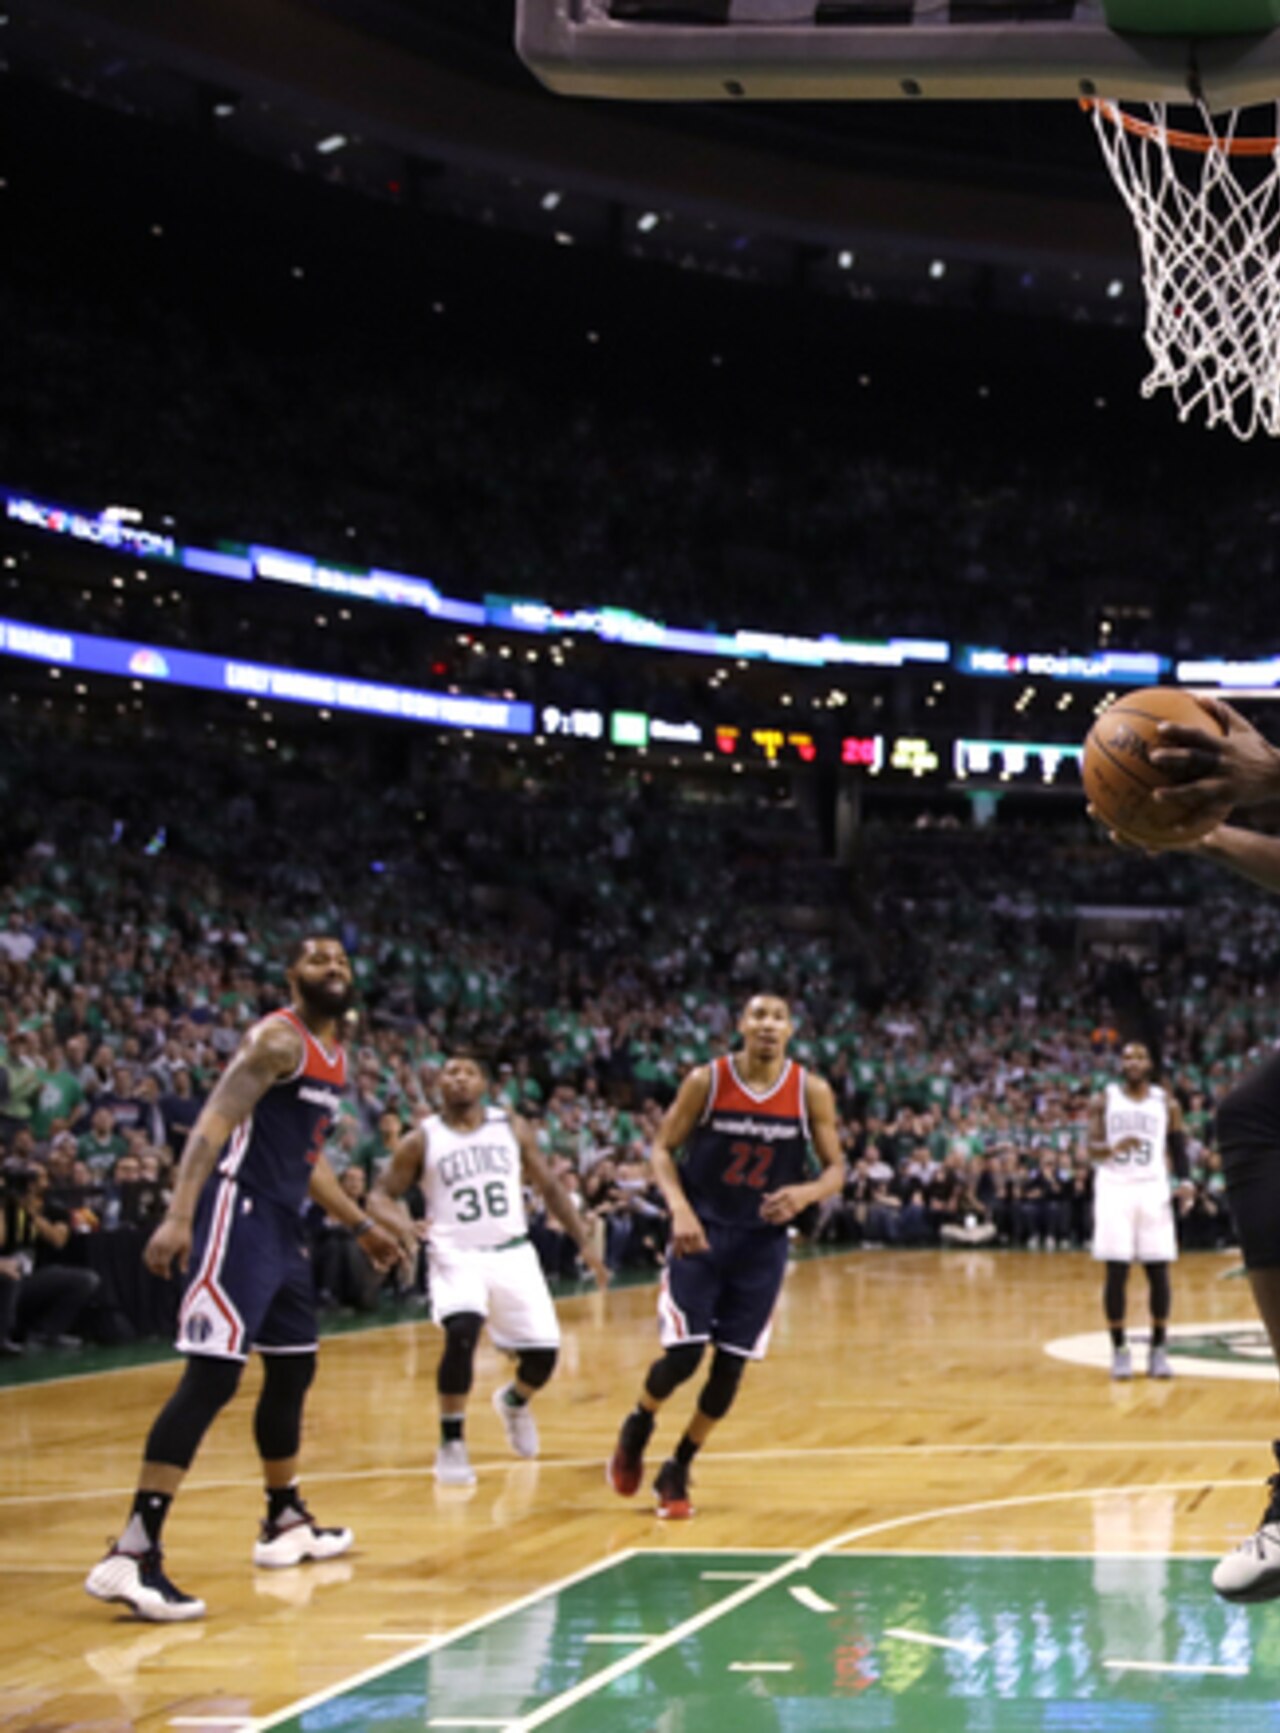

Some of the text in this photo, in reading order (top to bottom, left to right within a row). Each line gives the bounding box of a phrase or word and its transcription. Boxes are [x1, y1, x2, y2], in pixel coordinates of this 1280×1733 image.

[436, 1142, 512, 1187] CELTICS
[723, 1141, 775, 1189] 22
[452, 1180, 509, 1224] 36
